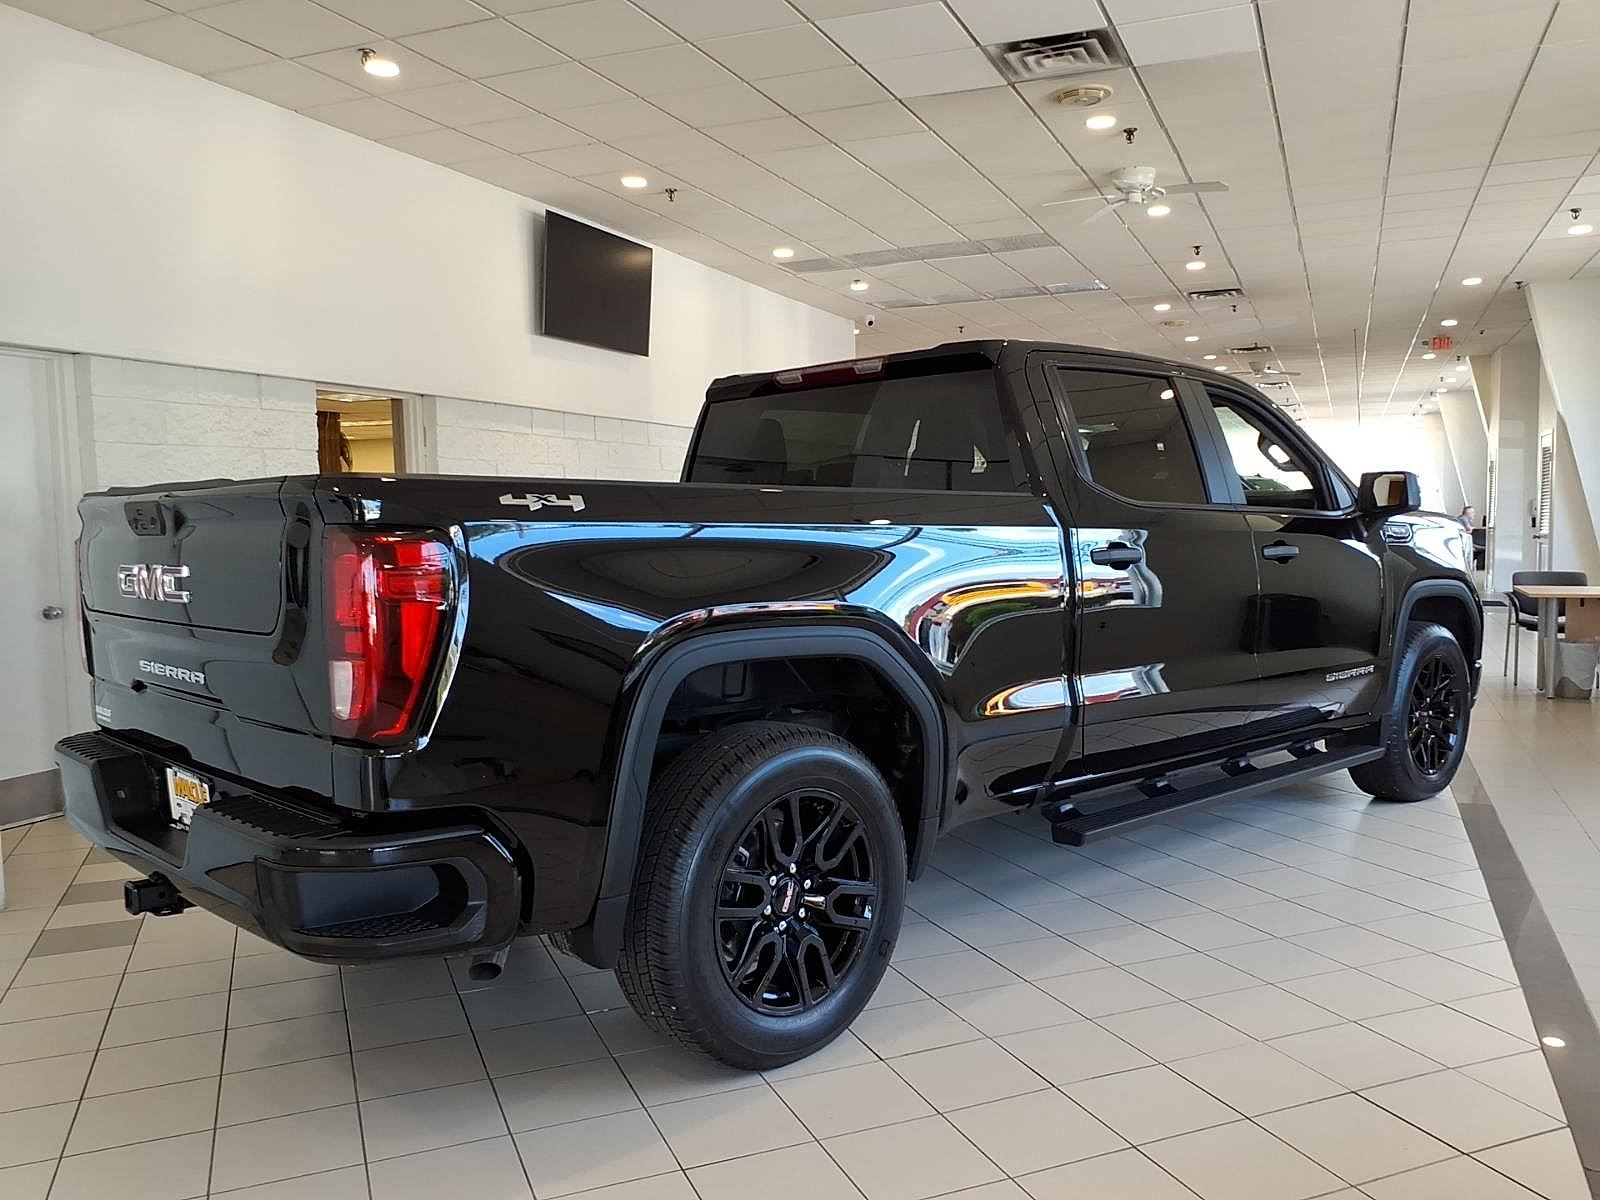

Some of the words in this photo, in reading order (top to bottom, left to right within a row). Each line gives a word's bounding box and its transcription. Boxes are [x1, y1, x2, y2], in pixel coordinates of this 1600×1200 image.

[118, 564, 190, 603] GMC
[138, 659, 205, 685] SIERRA
[1325, 664, 1375, 682] SIERRA
